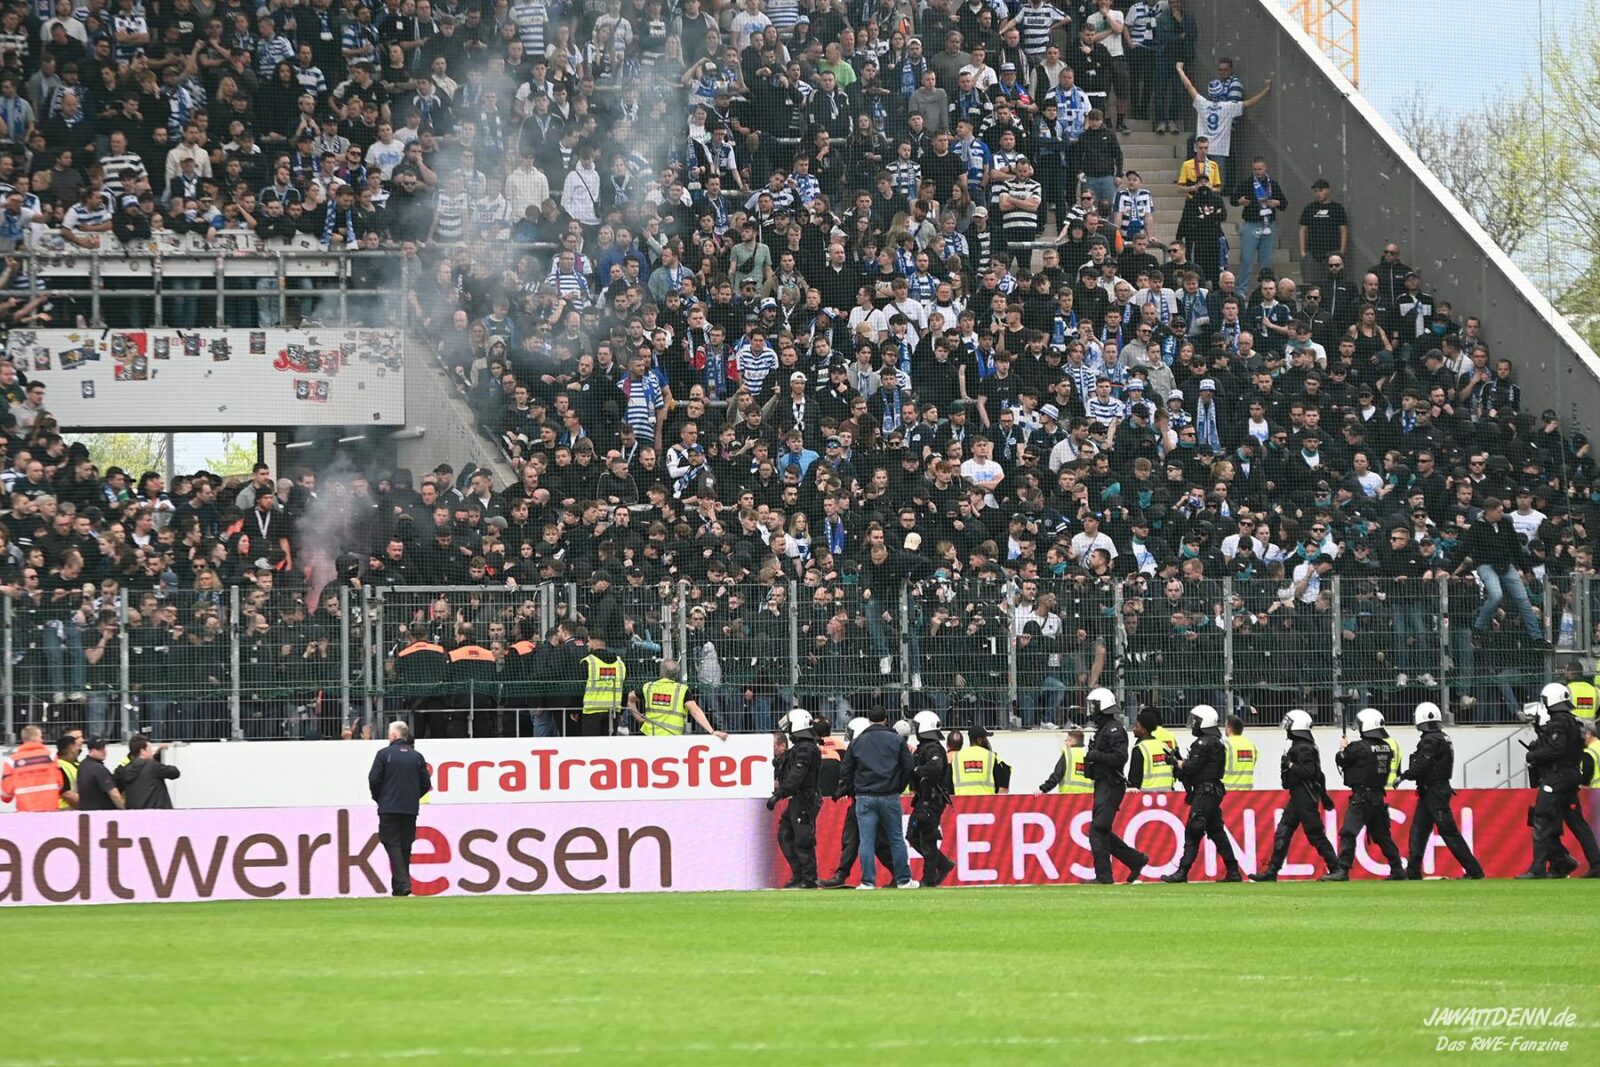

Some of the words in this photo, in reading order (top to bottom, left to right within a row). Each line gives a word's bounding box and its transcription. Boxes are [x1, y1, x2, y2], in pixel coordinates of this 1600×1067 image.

[1207, 113, 1219, 131] 9
[1371, 744, 1391, 753] POLIZE
[426, 744, 768, 792] rraTransfer
